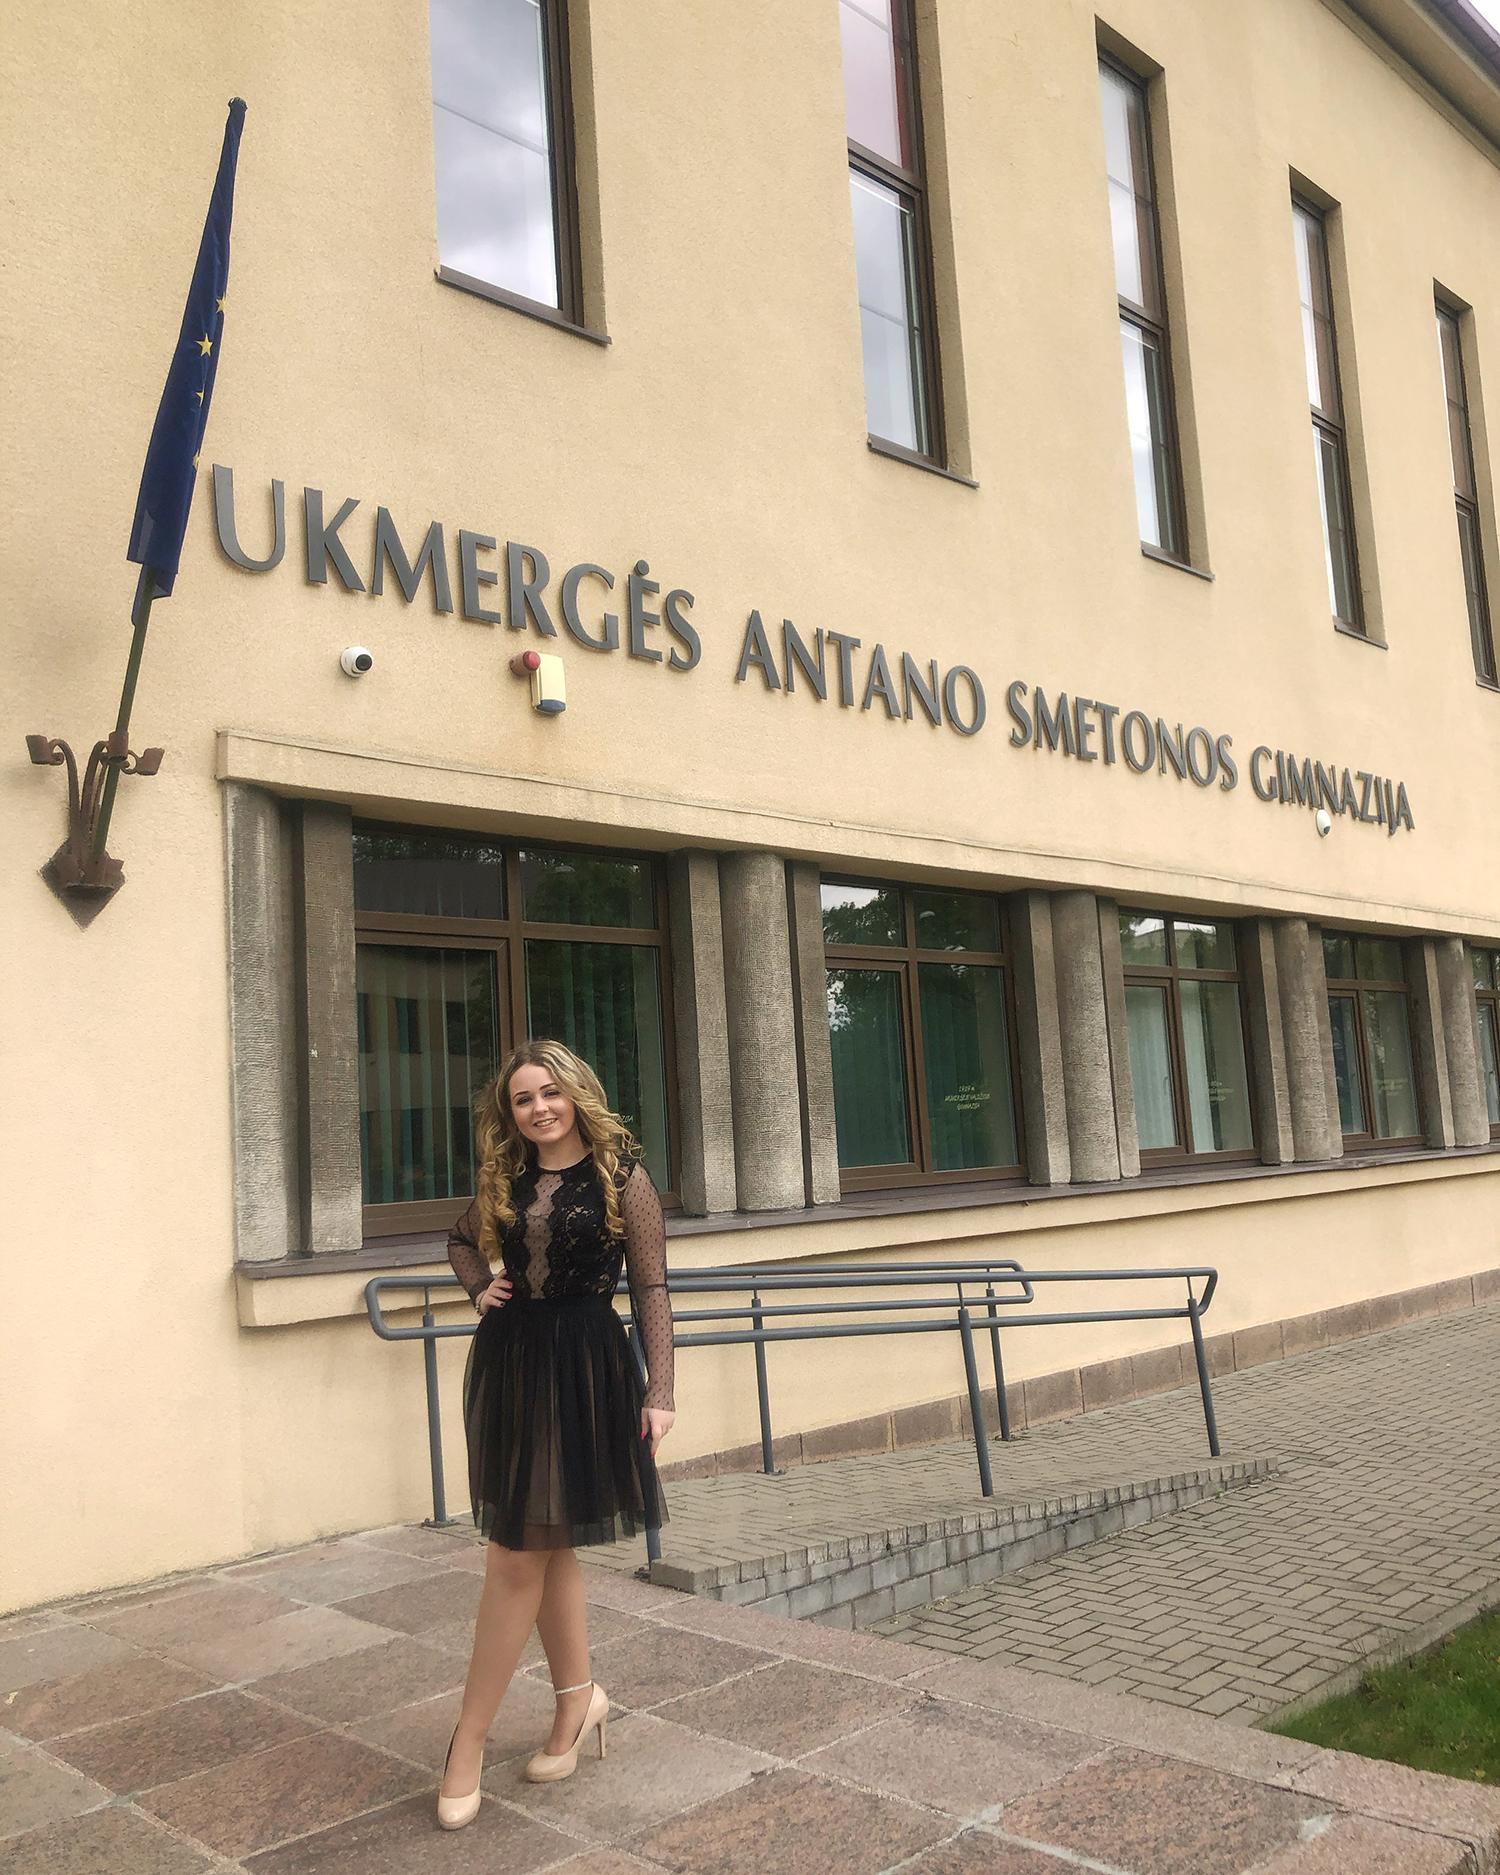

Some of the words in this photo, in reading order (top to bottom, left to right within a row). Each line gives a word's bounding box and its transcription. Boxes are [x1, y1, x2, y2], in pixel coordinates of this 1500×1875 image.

[211, 464, 702, 672] UKMERGĖS
[735, 609, 986, 737] ANTANO
[1007, 681, 1239, 792] SMETONOS
[1249, 745, 1415, 835] GIMNAZIJA
